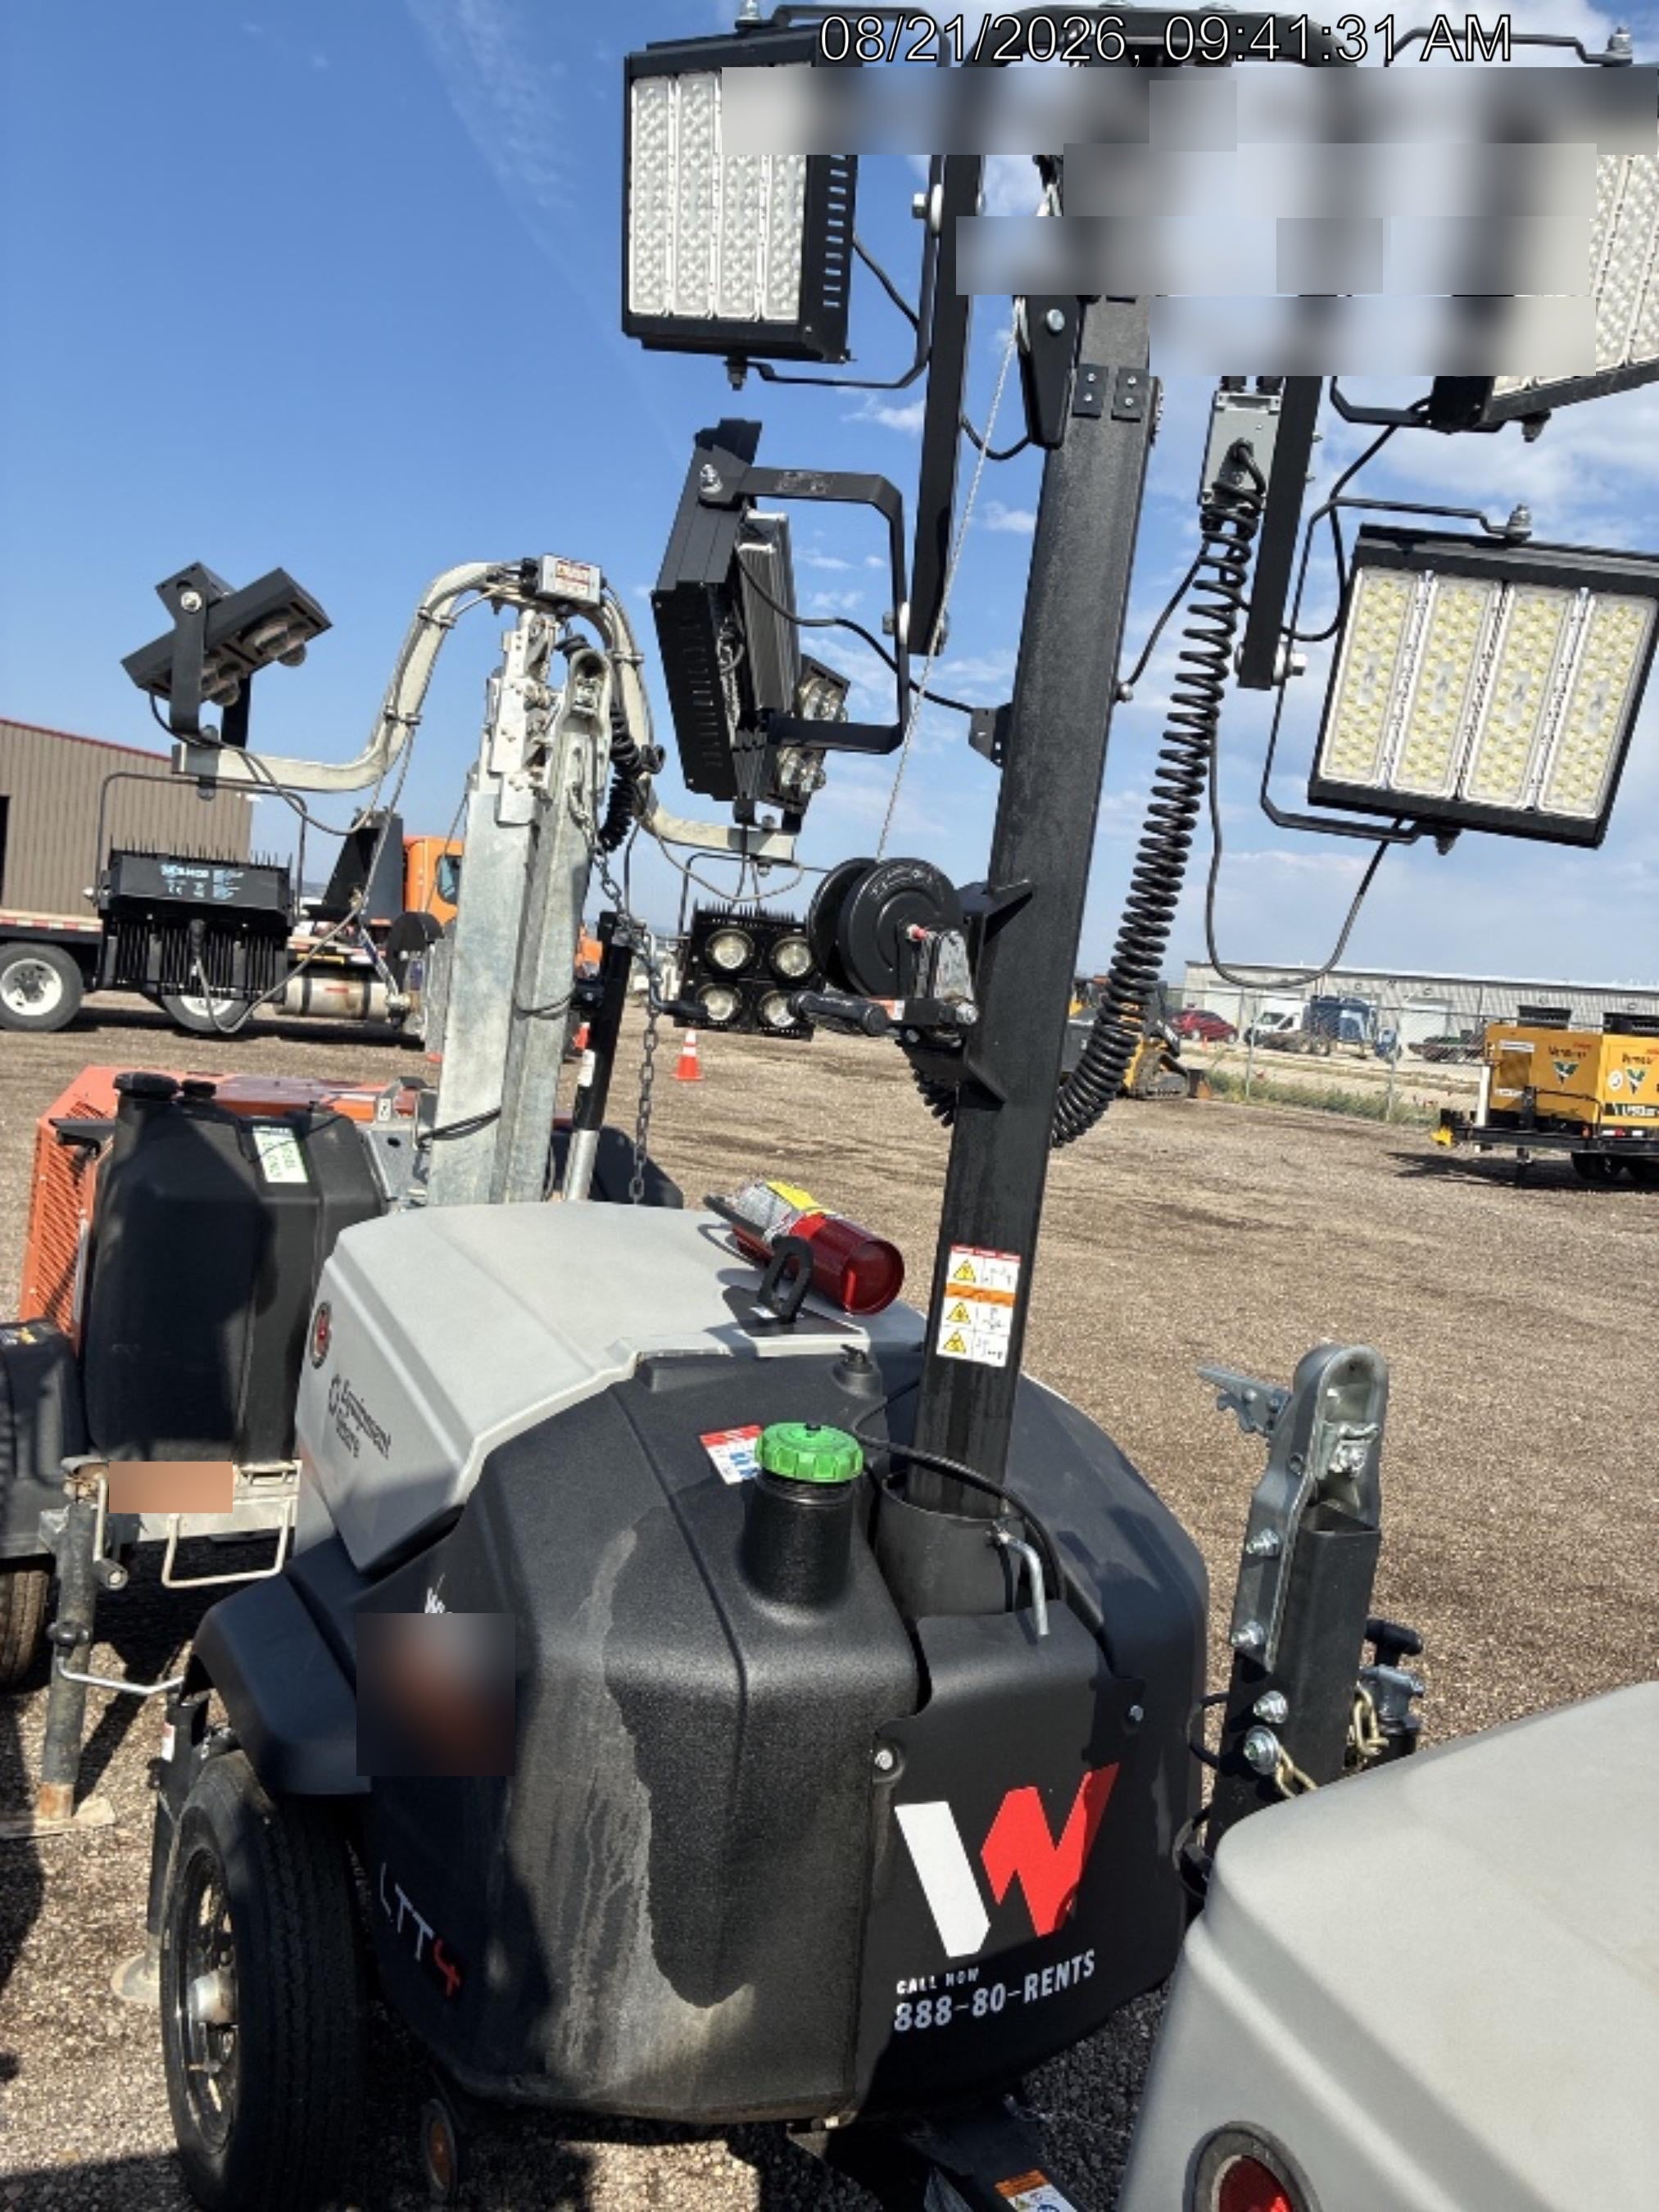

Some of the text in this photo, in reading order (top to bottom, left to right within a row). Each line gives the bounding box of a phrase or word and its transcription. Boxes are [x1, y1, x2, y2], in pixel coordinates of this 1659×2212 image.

[894, 1948, 1095, 2032] 888-80-RENTS
[896, 1967, 979, 1995] CALL NOW
